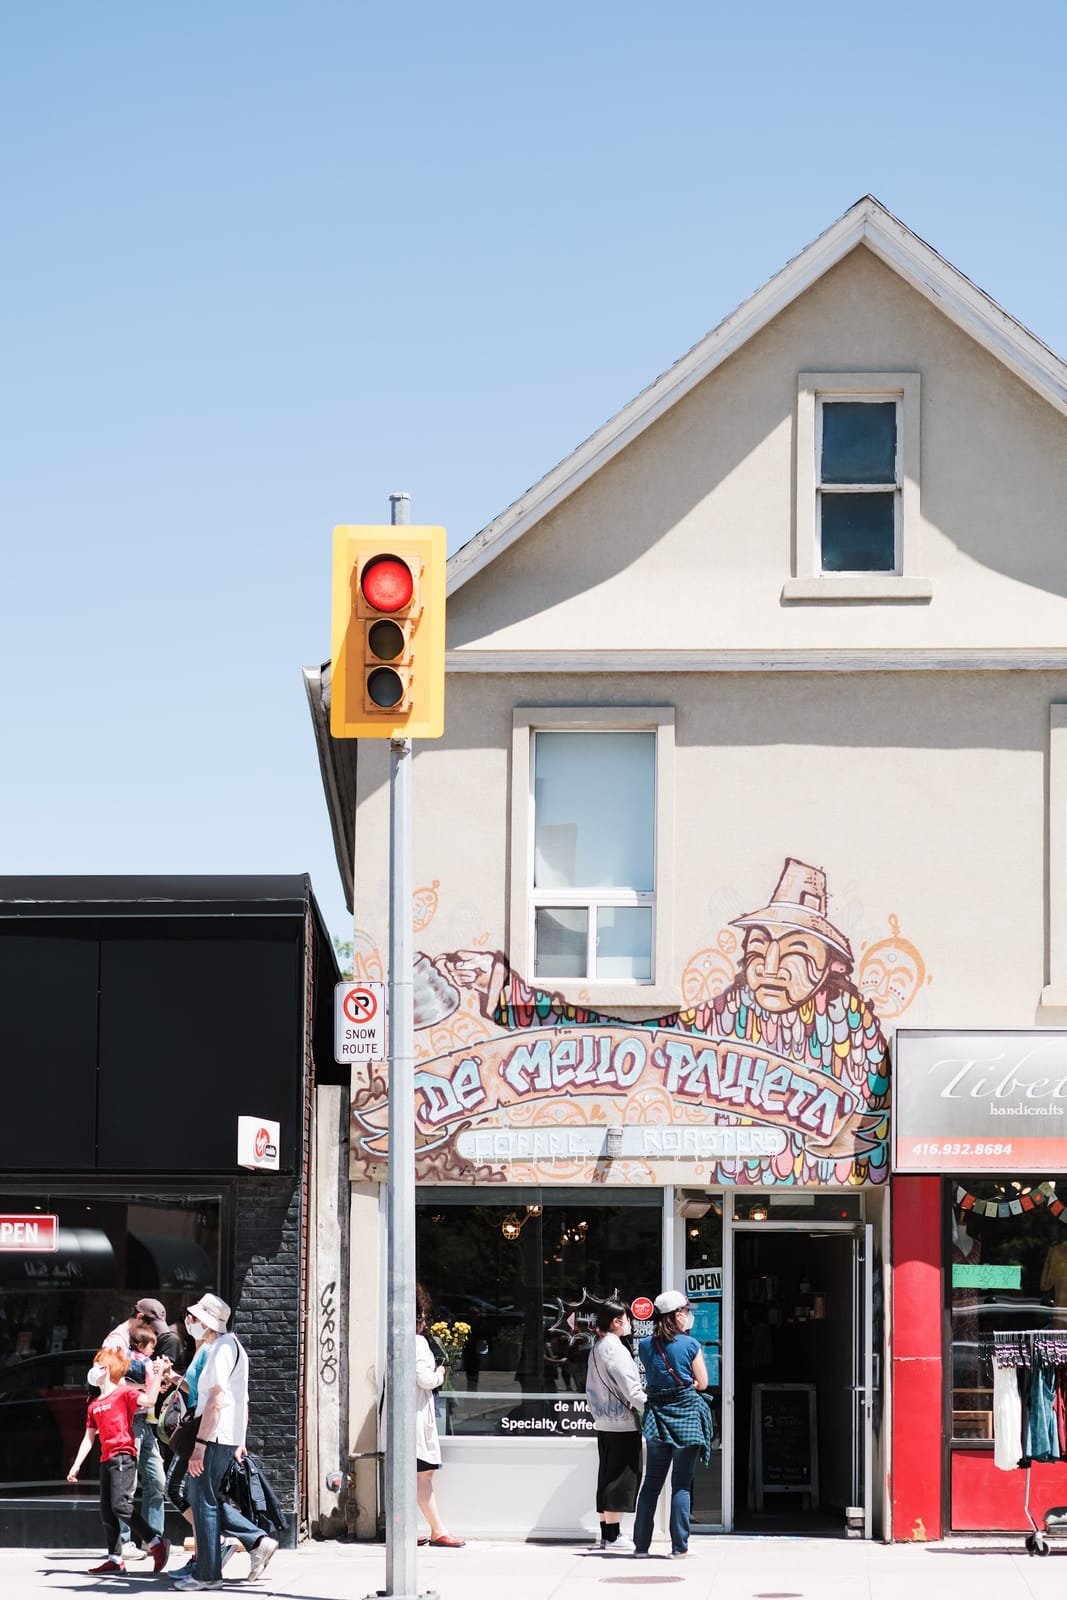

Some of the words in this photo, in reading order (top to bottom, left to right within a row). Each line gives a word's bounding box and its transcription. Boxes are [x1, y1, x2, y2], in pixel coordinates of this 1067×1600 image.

[345, 1029, 375, 1039] SNOW
[342, 1043, 378, 1054] ROUTE
[989, 1102, 1064, 1115] handicrafts
[912, 1143, 1013, 1156] 416.932.8684
[0, 1222, 38, 1243] PEN
[688, 1272, 721, 1291] OPEN
[553, 1400, 569, 1412] de
[573, 1400, 592, 1412] Me
[501, 1417, 557, 1431] Specialty
